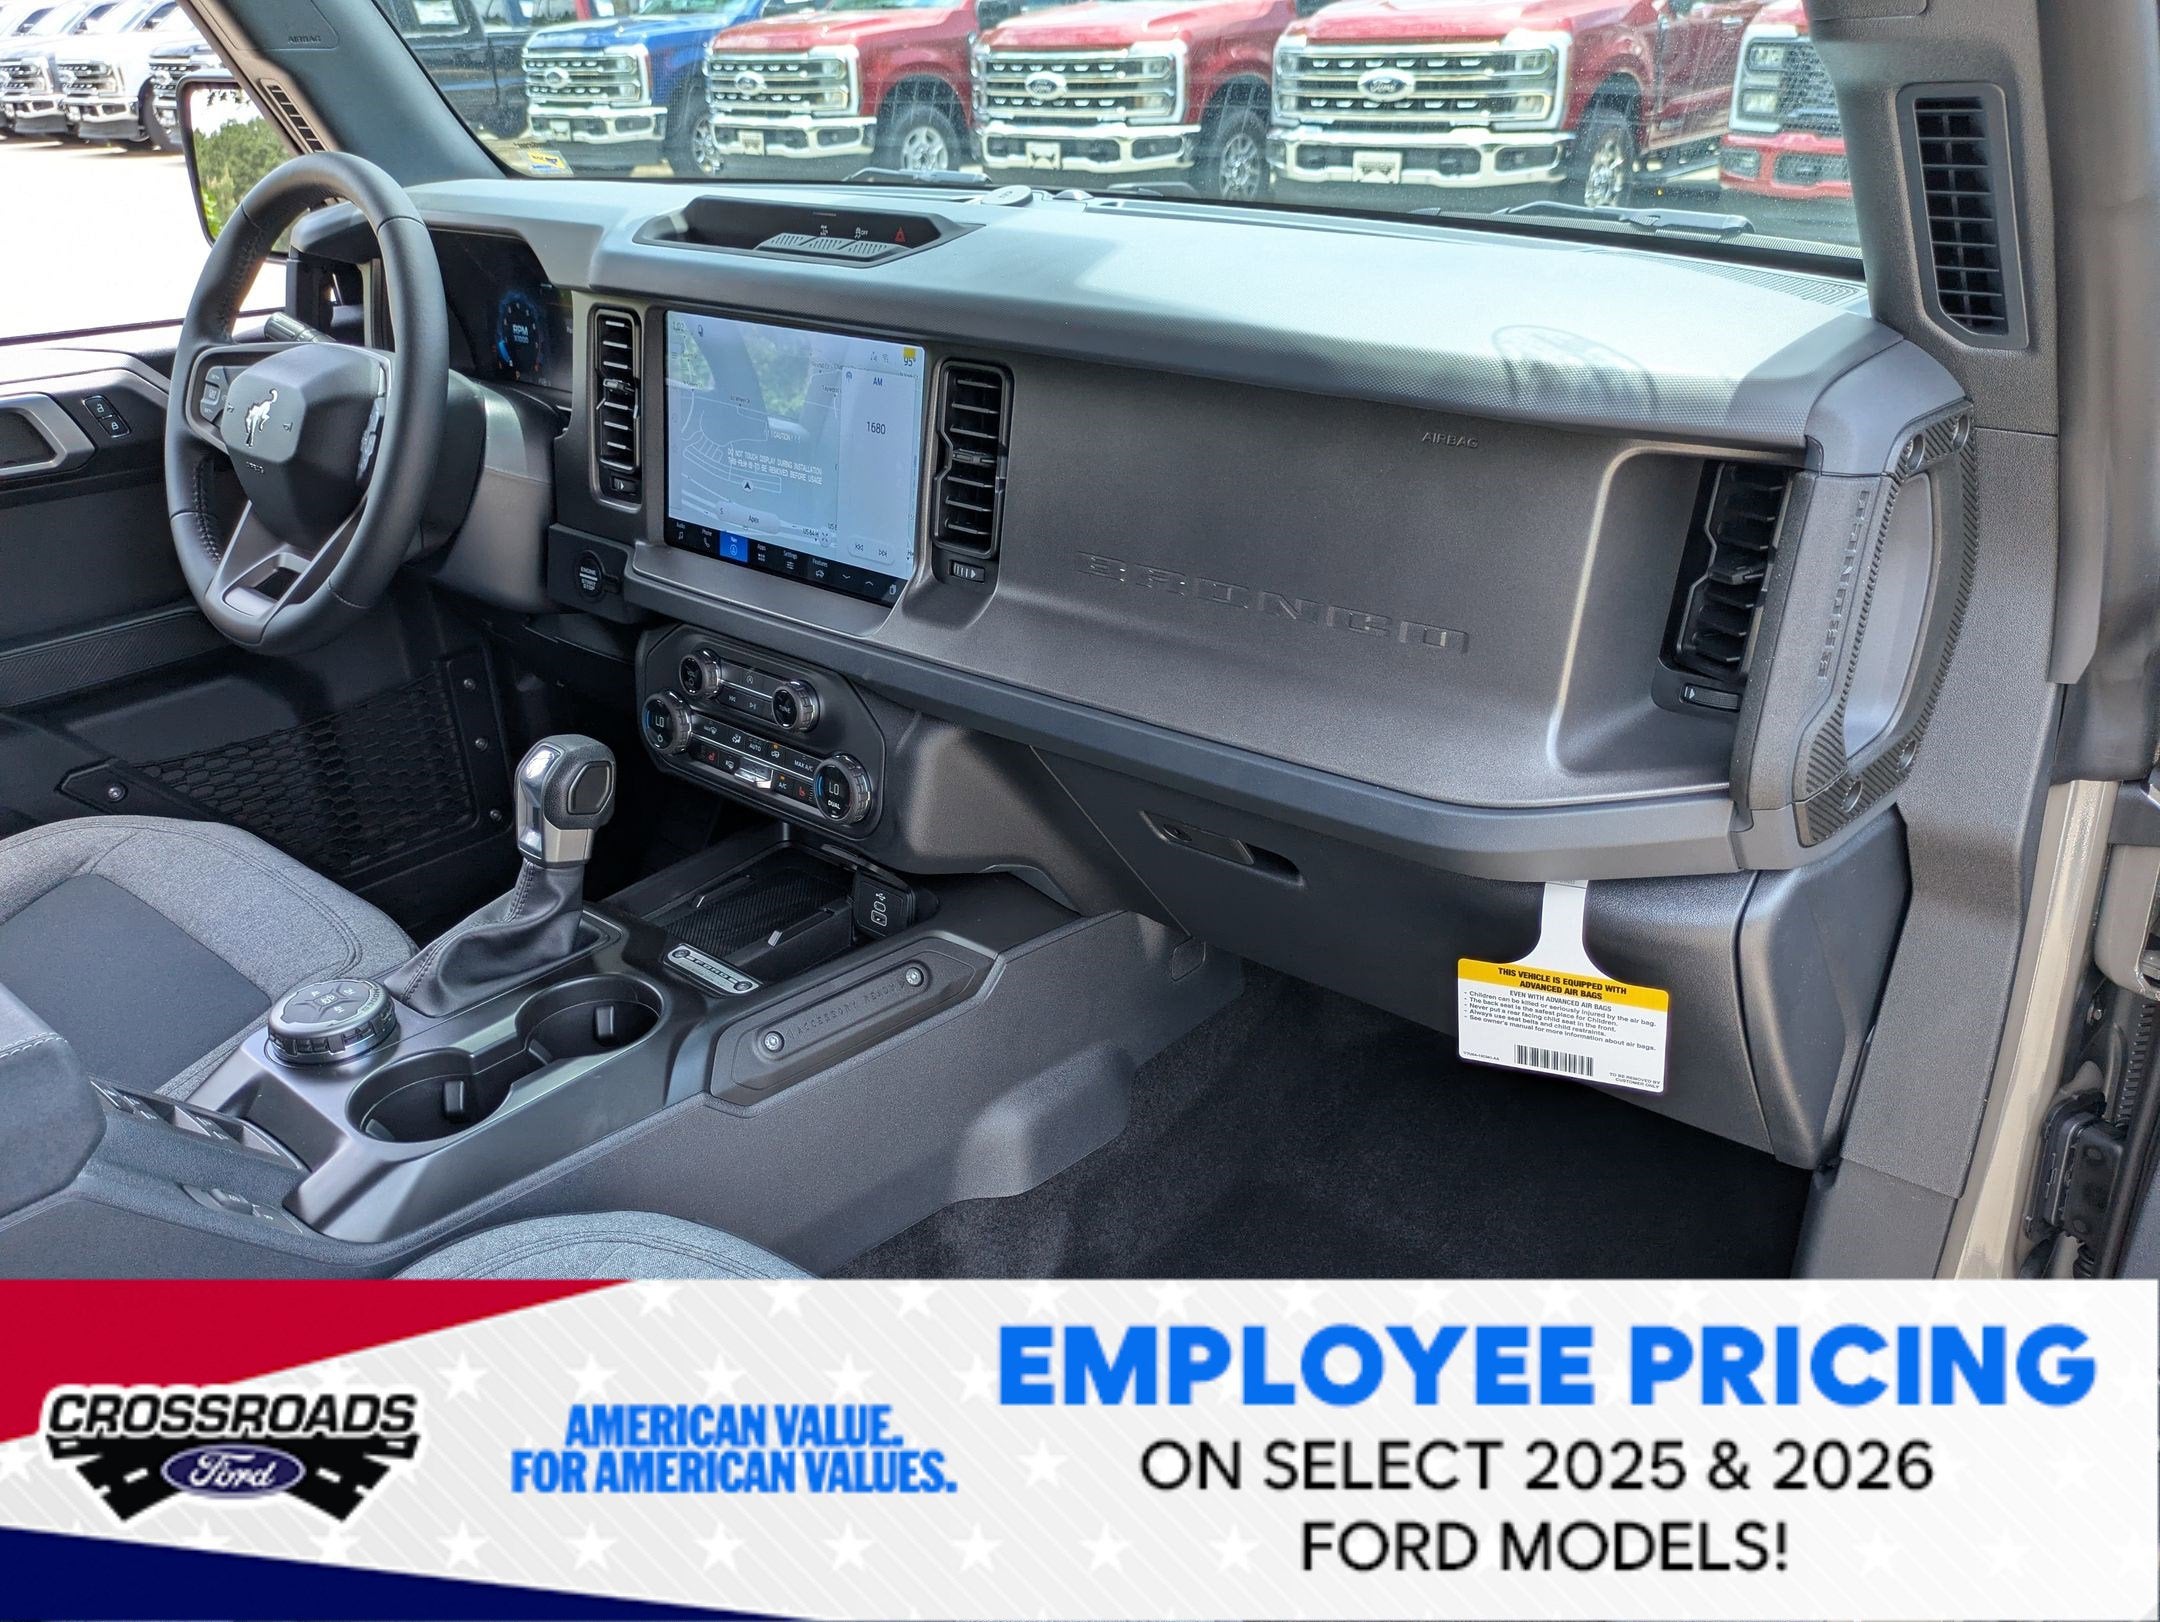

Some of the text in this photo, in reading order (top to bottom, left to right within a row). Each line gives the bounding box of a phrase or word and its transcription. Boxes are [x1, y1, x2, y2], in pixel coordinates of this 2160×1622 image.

[512, 324, 528, 336] RPM
[873, 377, 883, 386] AM
[867, 421, 886, 434] 1680
[1422, 432, 1478, 448] AIRBAG
[1817, 489, 1870, 680] BRONCO
[1077, 551, 1469, 653] BRONCO
[749, 743, 761, 752] AUTO
[829, 782, 840, 795] LO
[827, 800, 840, 809] DUAL
[1498, 967, 1627, 993] THIS VEHICLE IS EQUIPPED WITH
[1520, 980, 1603, 999] ADVANCED AIR BAGS
[1469, 990, 1497, 1000] Children
[1549, 1003, 1580, 1014] seriously
[1581, 1008, 1606, 1018] injured
[1607, 1012, 1616, 1020] by
[1640, 1018, 1656, 1027] bag.
[1545, 996, 1580, 1006] ADVANCED
[1594, 1003, 1612, 1011] BAGS
[1469, 1008, 1493, 1018] Always
[1572, 1026, 1606, 1036] restraints.
[1521, 1011, 1542, 1020] facing
[1597, 1024, 1617, 1032] front.
[1535, 1007, 1555, 1015] safest
[1556, 1011, 1575, 1019] place
[1587, 1016, 1618, 1025] Children.
[1483, 1017, 1508, 1025] owner's
[1509, 1021, 1534, 1030] manual
[1565, 1030, 1603, 1042] information
[1604, 1037, 1625, 1045] about
[1636, 1043, 1656, 1052] bags.
